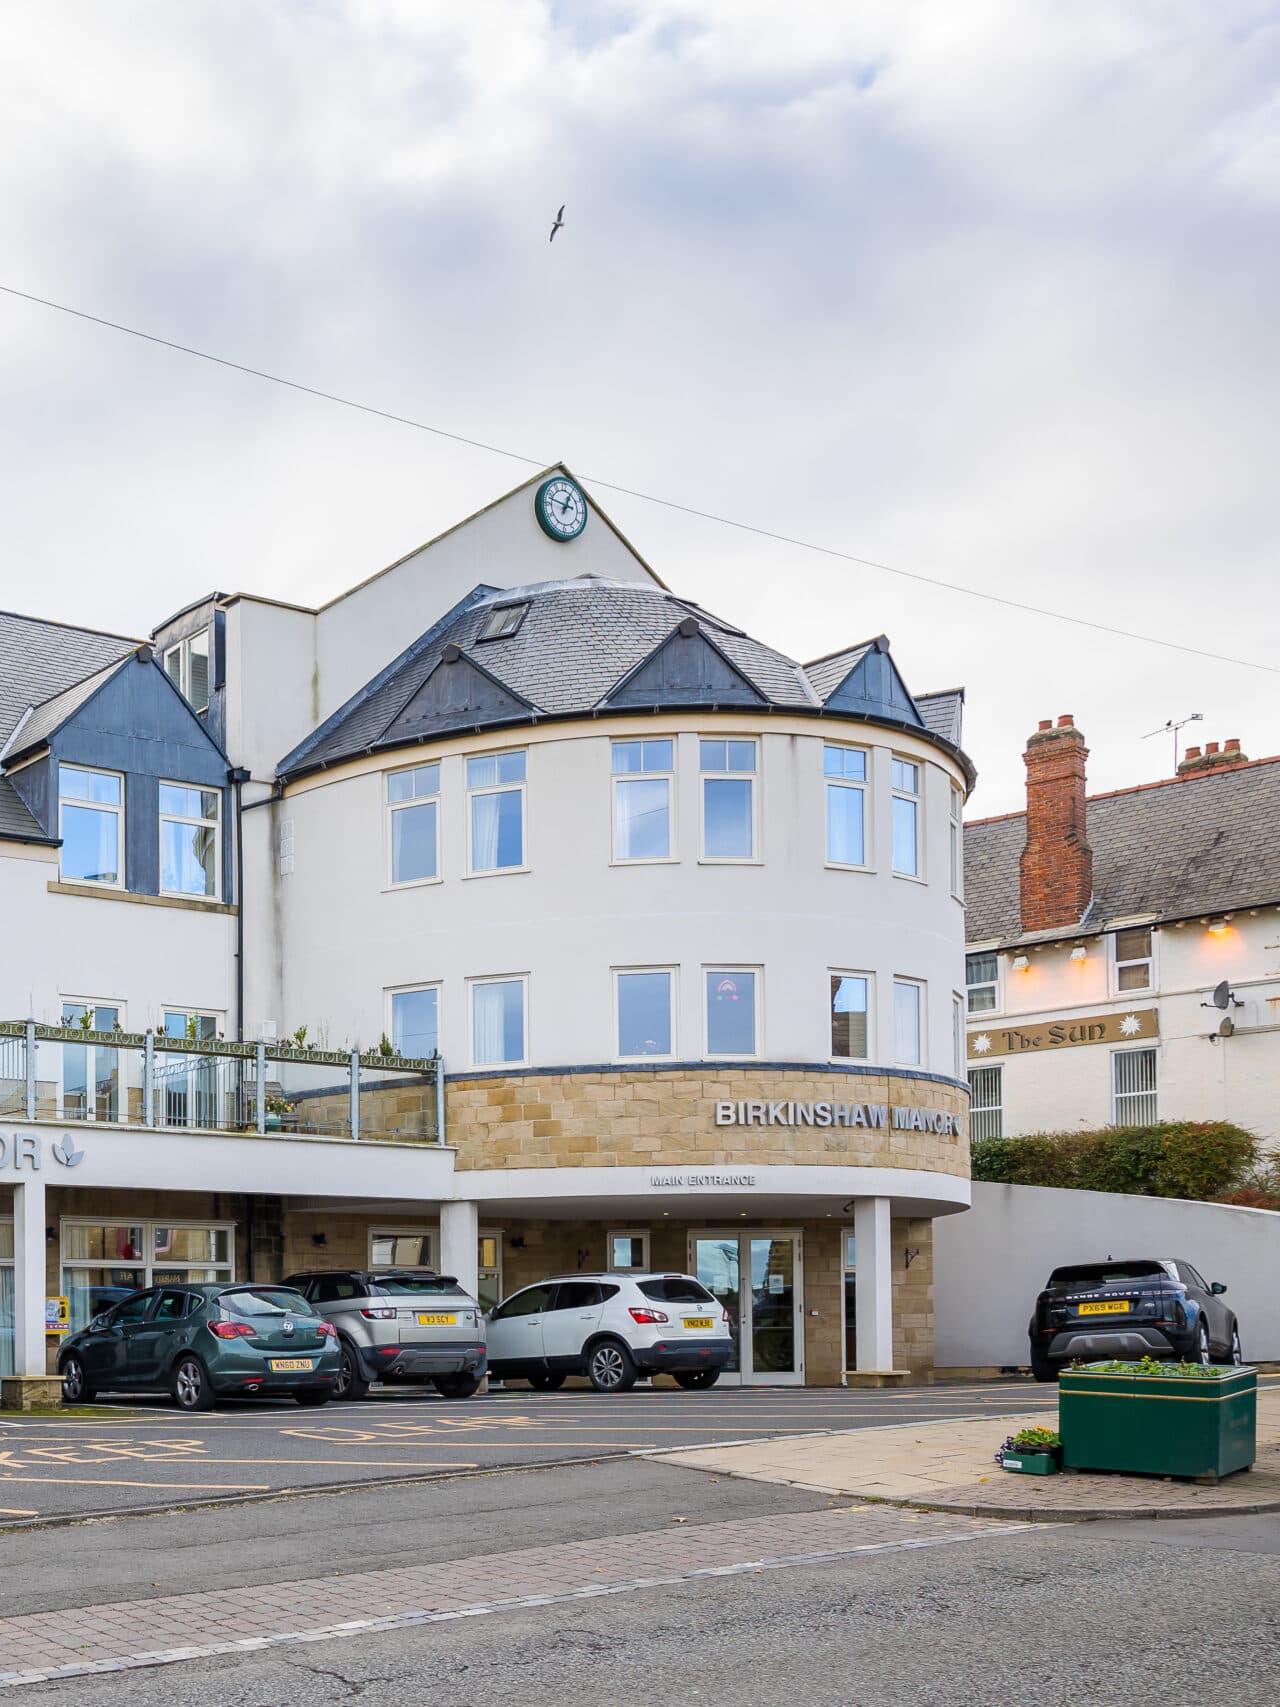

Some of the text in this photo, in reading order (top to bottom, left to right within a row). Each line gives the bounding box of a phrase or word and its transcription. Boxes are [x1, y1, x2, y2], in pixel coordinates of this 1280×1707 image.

[1001, 1030, 1043, 1051] The
[715, 1100, 953, 1136] BIRKINSHAW MANOR
[650, 1175, 757, 1187] MAIN ENTRANCE
[278, 1415, 546, 1442] CLEAR
